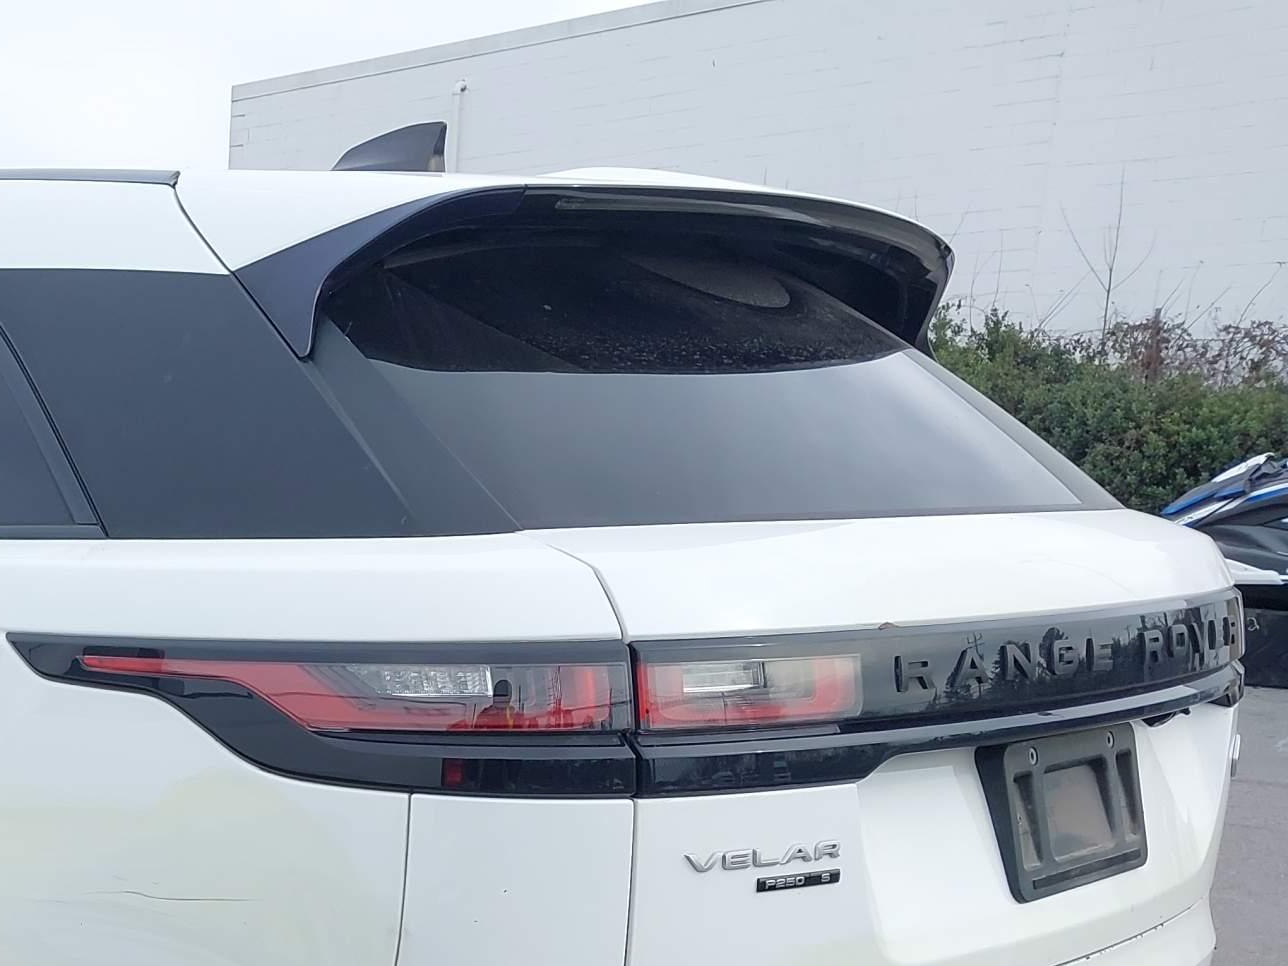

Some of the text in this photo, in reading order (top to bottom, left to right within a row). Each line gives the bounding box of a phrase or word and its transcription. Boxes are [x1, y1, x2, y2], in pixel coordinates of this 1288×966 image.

[894, 636, 1114, 692] RANGE
[682, 839, 840, 872] VELAR
[765, 872, 831, 889] P250 S
